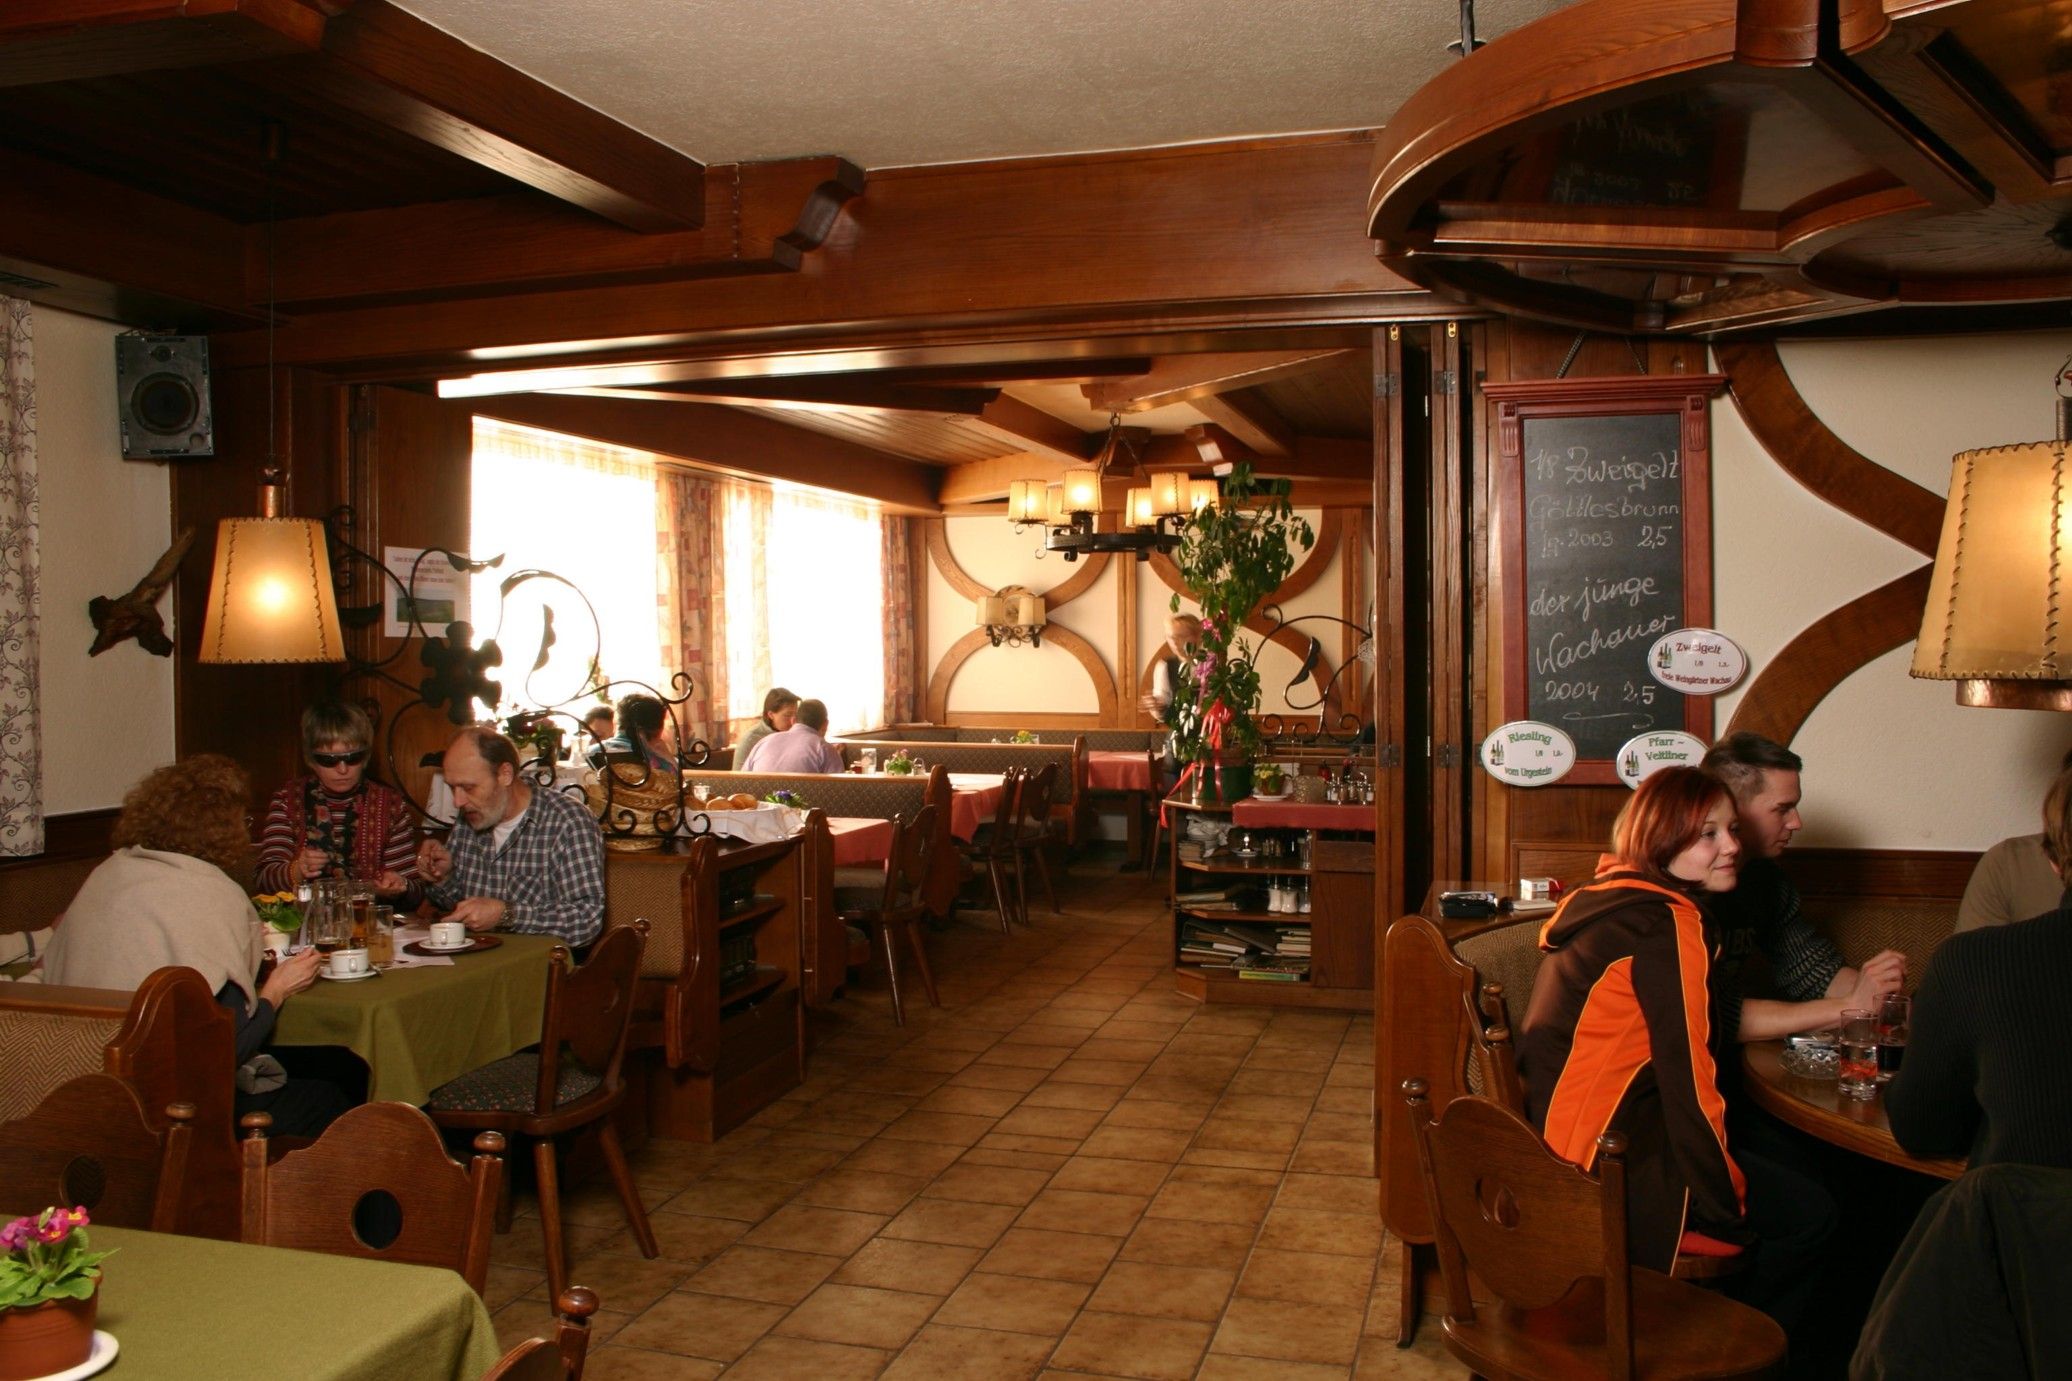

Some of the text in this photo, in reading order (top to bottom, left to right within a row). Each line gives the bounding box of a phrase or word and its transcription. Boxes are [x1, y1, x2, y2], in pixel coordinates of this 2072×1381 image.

[1564, 446, 1679, 493] Zweigelt
[1567, 528, 1614, 548] 2003
[1529, 588, 1570, 616] der
[1536, 614, 1676, 675] Wachauer
[1544, 680, 1600, 702] 2004
[1508, 731, 1552, 746] Riesling
[1648, 736, 1675, 747] Pfarr
[1645, 751, 1689, 760] Veltliner
